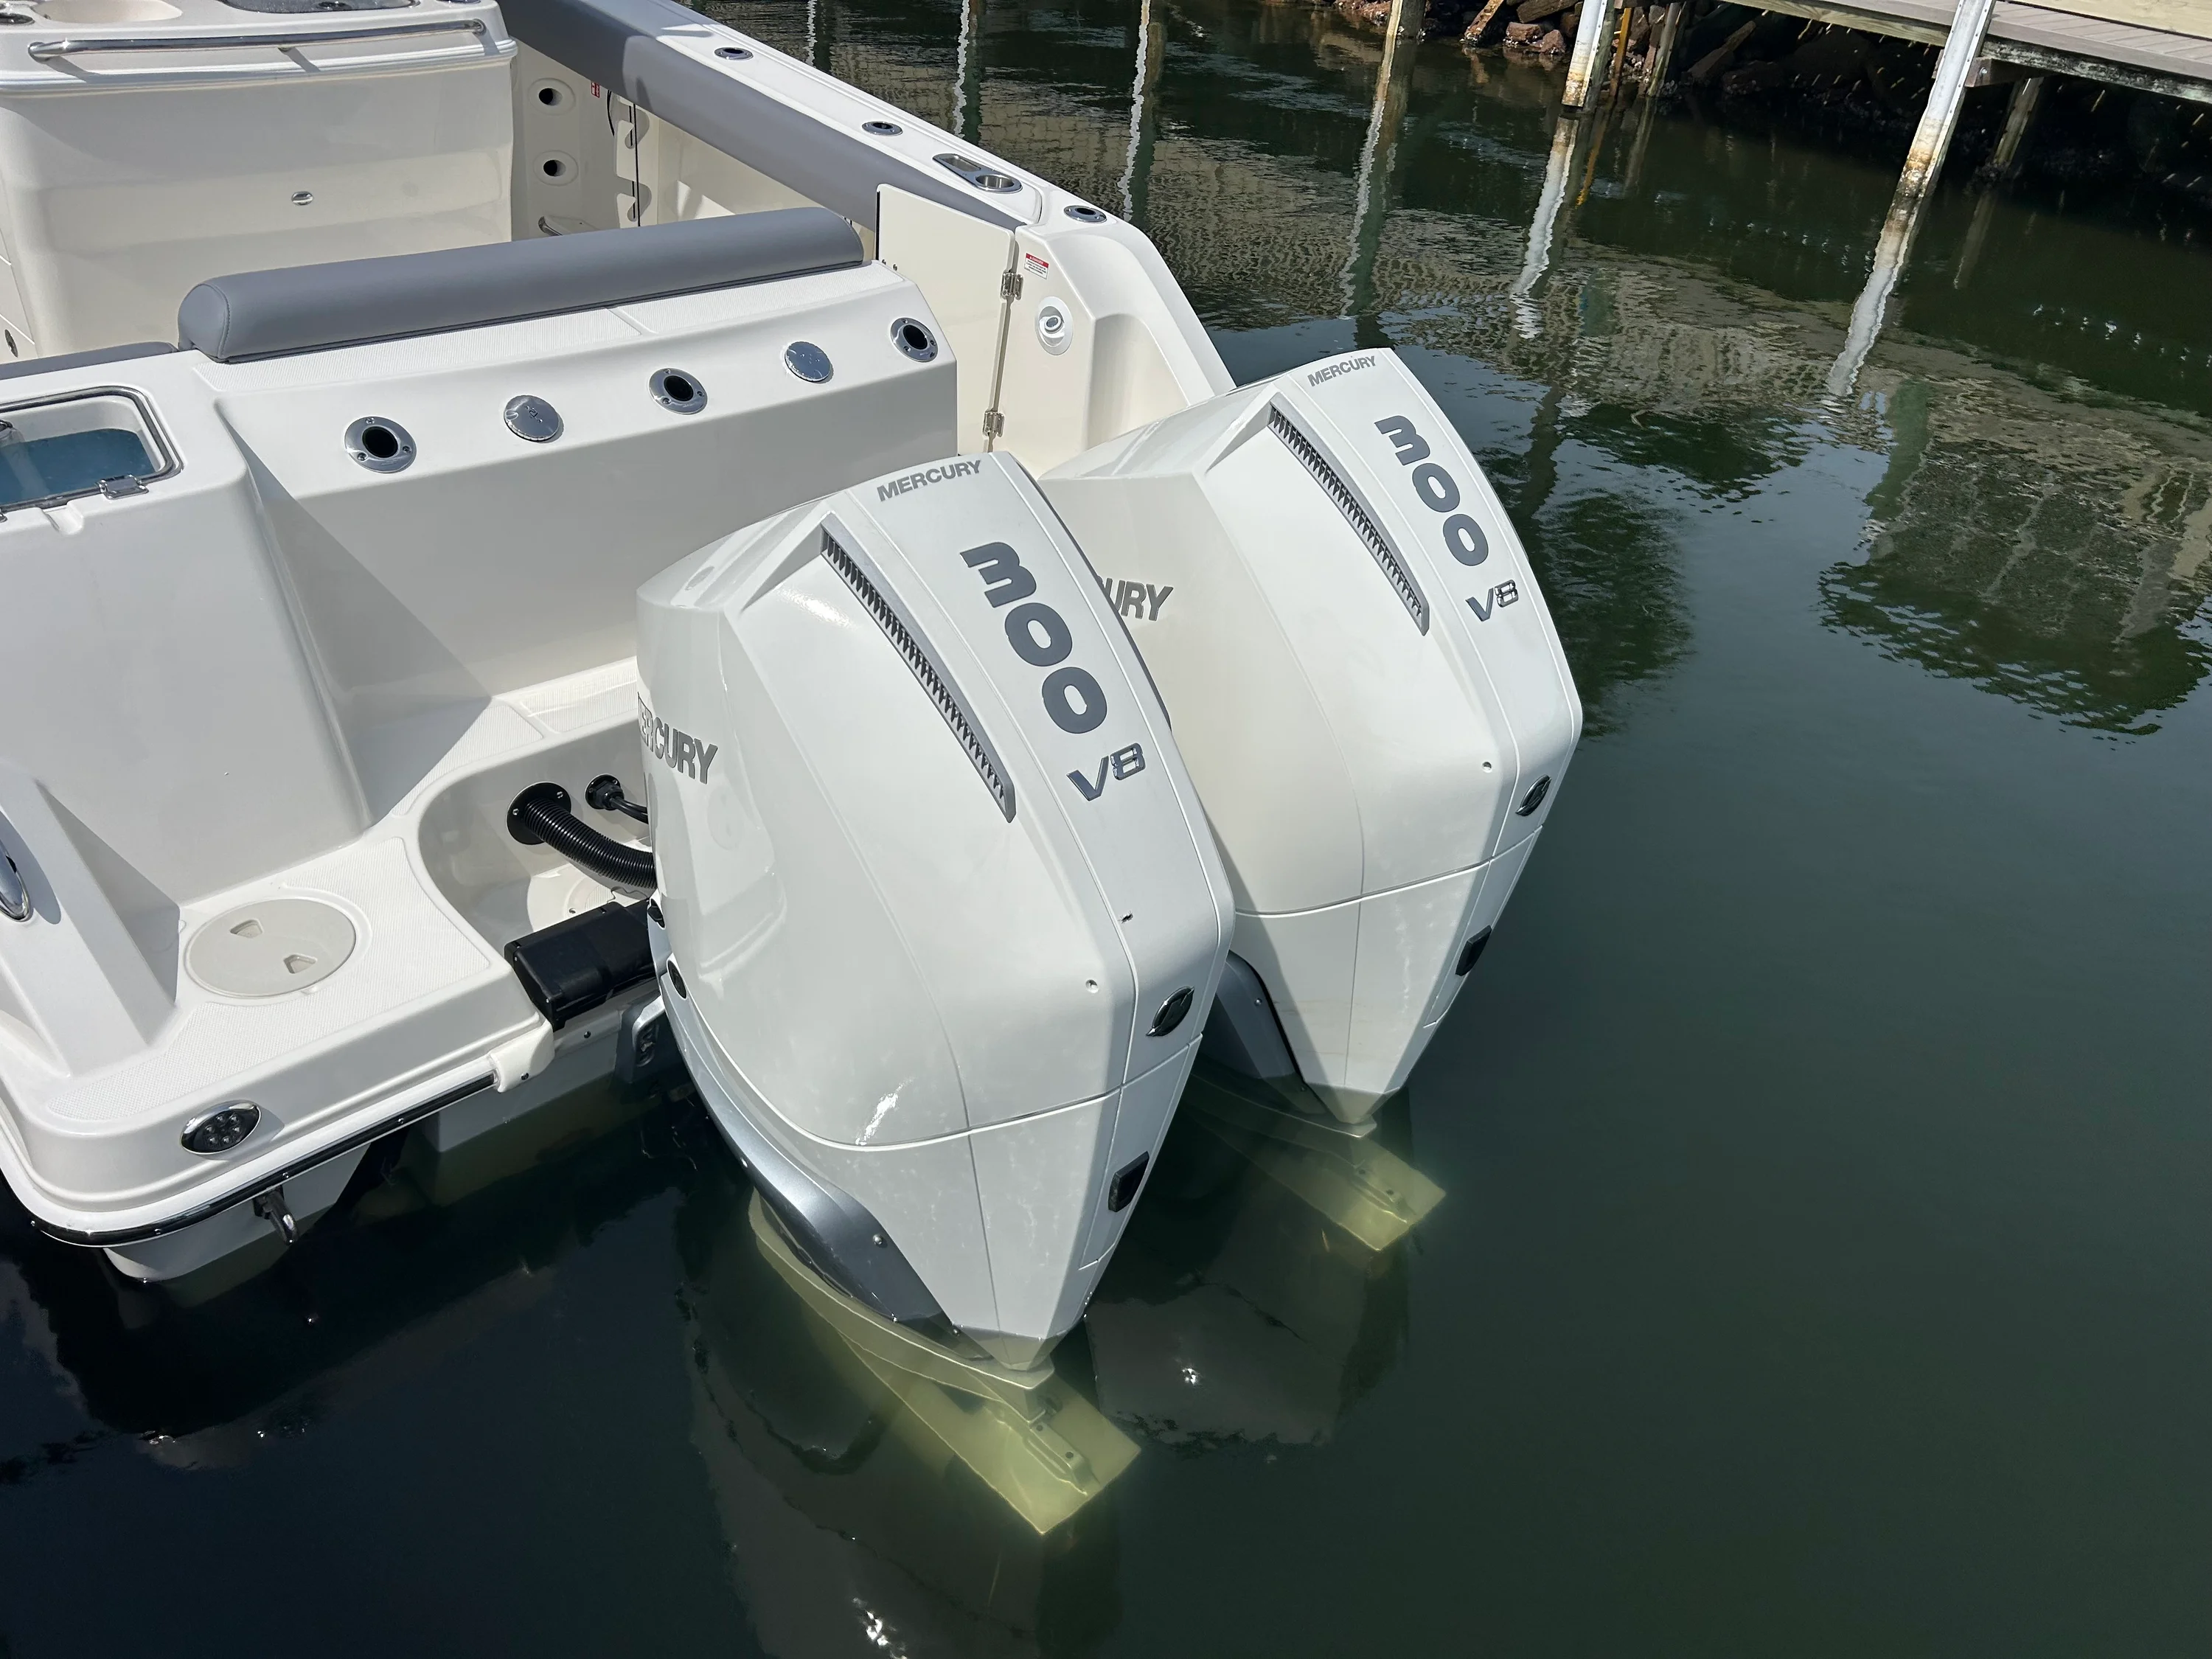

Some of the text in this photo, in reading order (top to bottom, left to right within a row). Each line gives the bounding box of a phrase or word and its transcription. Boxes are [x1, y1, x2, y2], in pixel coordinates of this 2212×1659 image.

[1307, 355, 1376, 387] MERCURY
[876, 459, 981, 502] MERCURY
[1374, 415, 1489, 566] 300
[1097, 575, 1174, 622] URY
[1465, 579, 1520, 622] V8
[959, 541, 1108, 734] 300
[637, 692, 719, 785] ERCURY
[1066, 742, 1147, 801] V8
